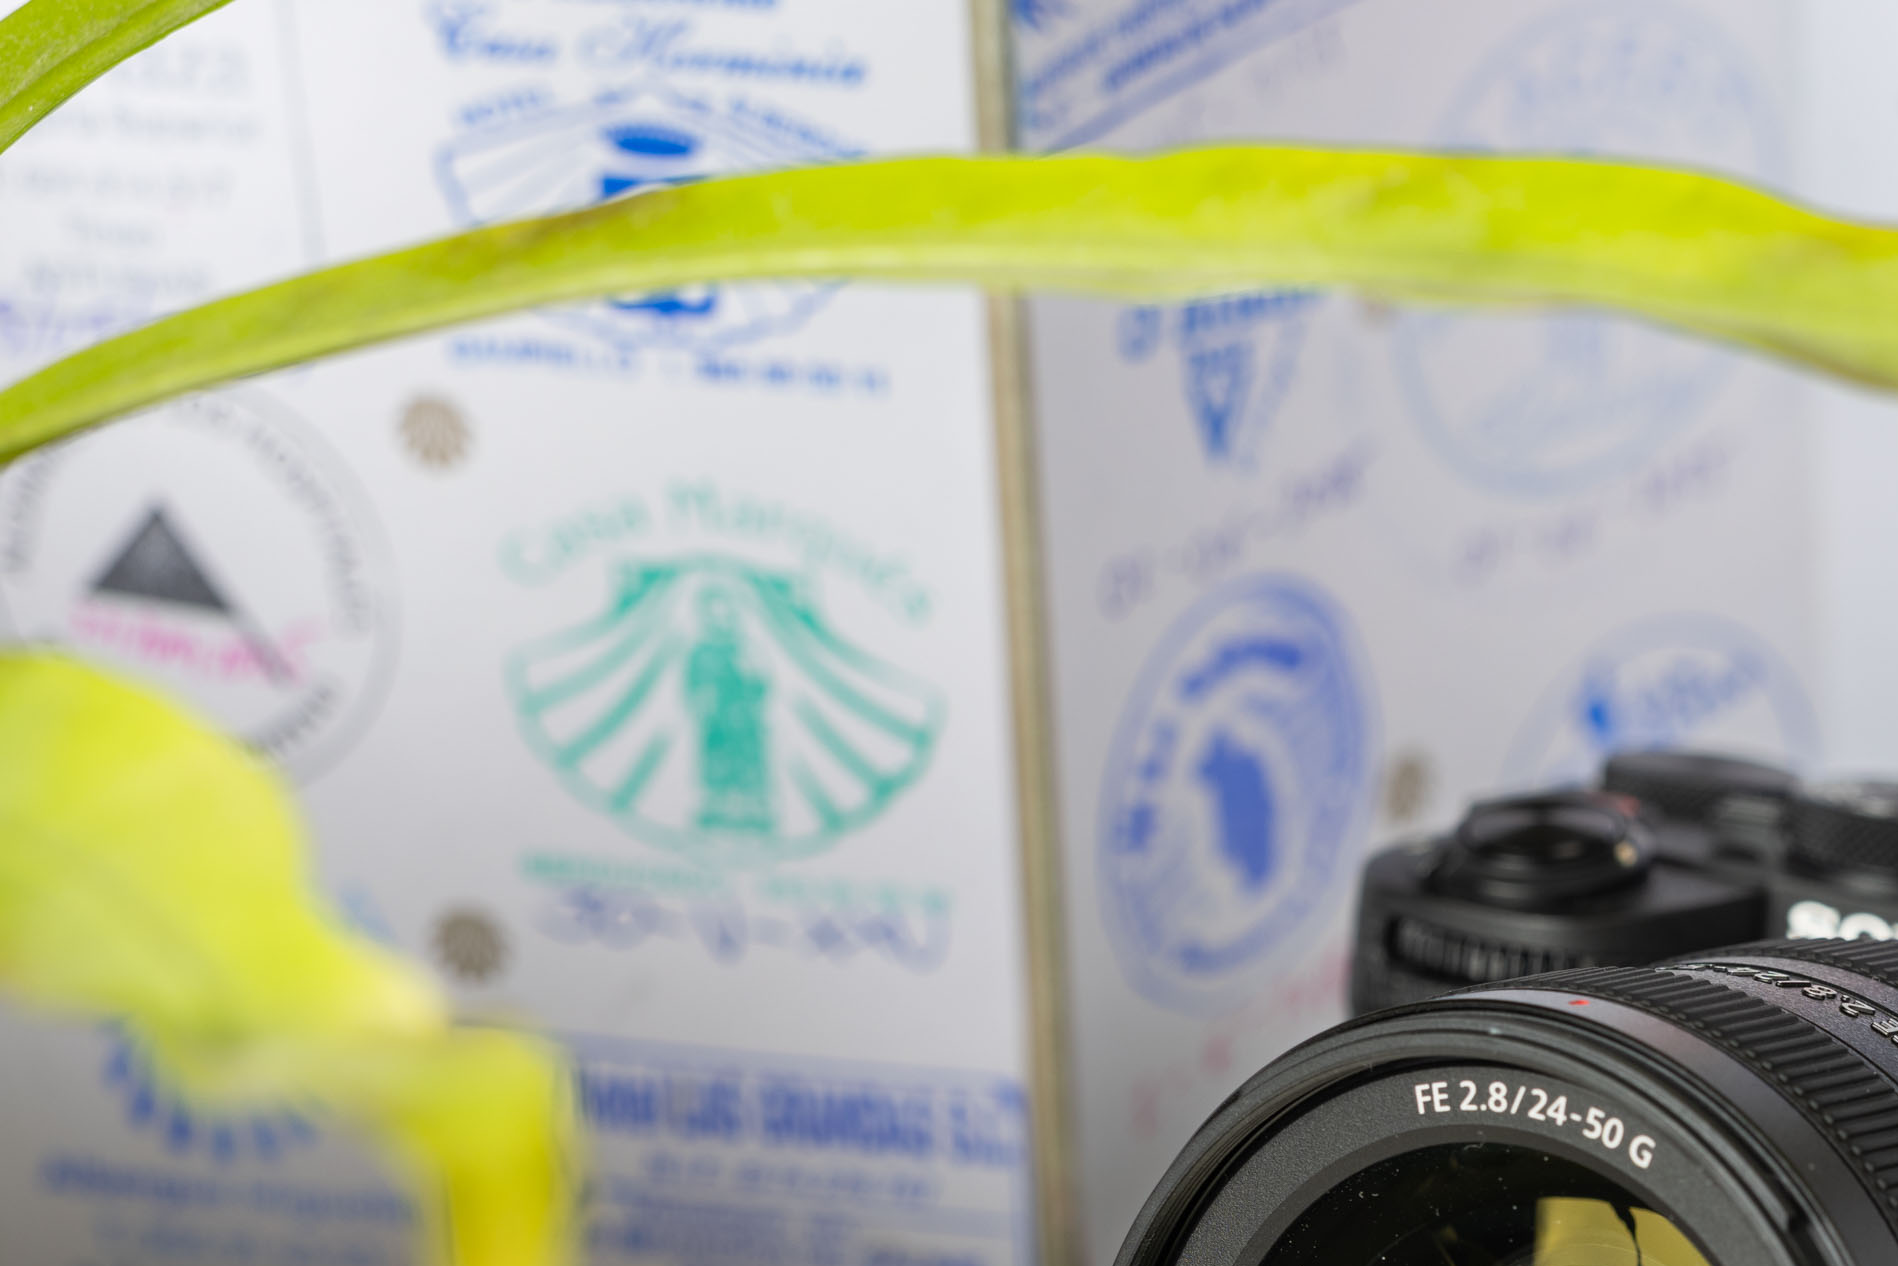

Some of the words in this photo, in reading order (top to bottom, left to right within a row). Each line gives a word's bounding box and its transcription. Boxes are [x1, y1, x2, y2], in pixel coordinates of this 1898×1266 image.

[1414, 1081, 1451, 1115] FE
[1459, 1080, 1625, 1150] 2.8/24-50
[1628, 1134, 1657, 1170] G
